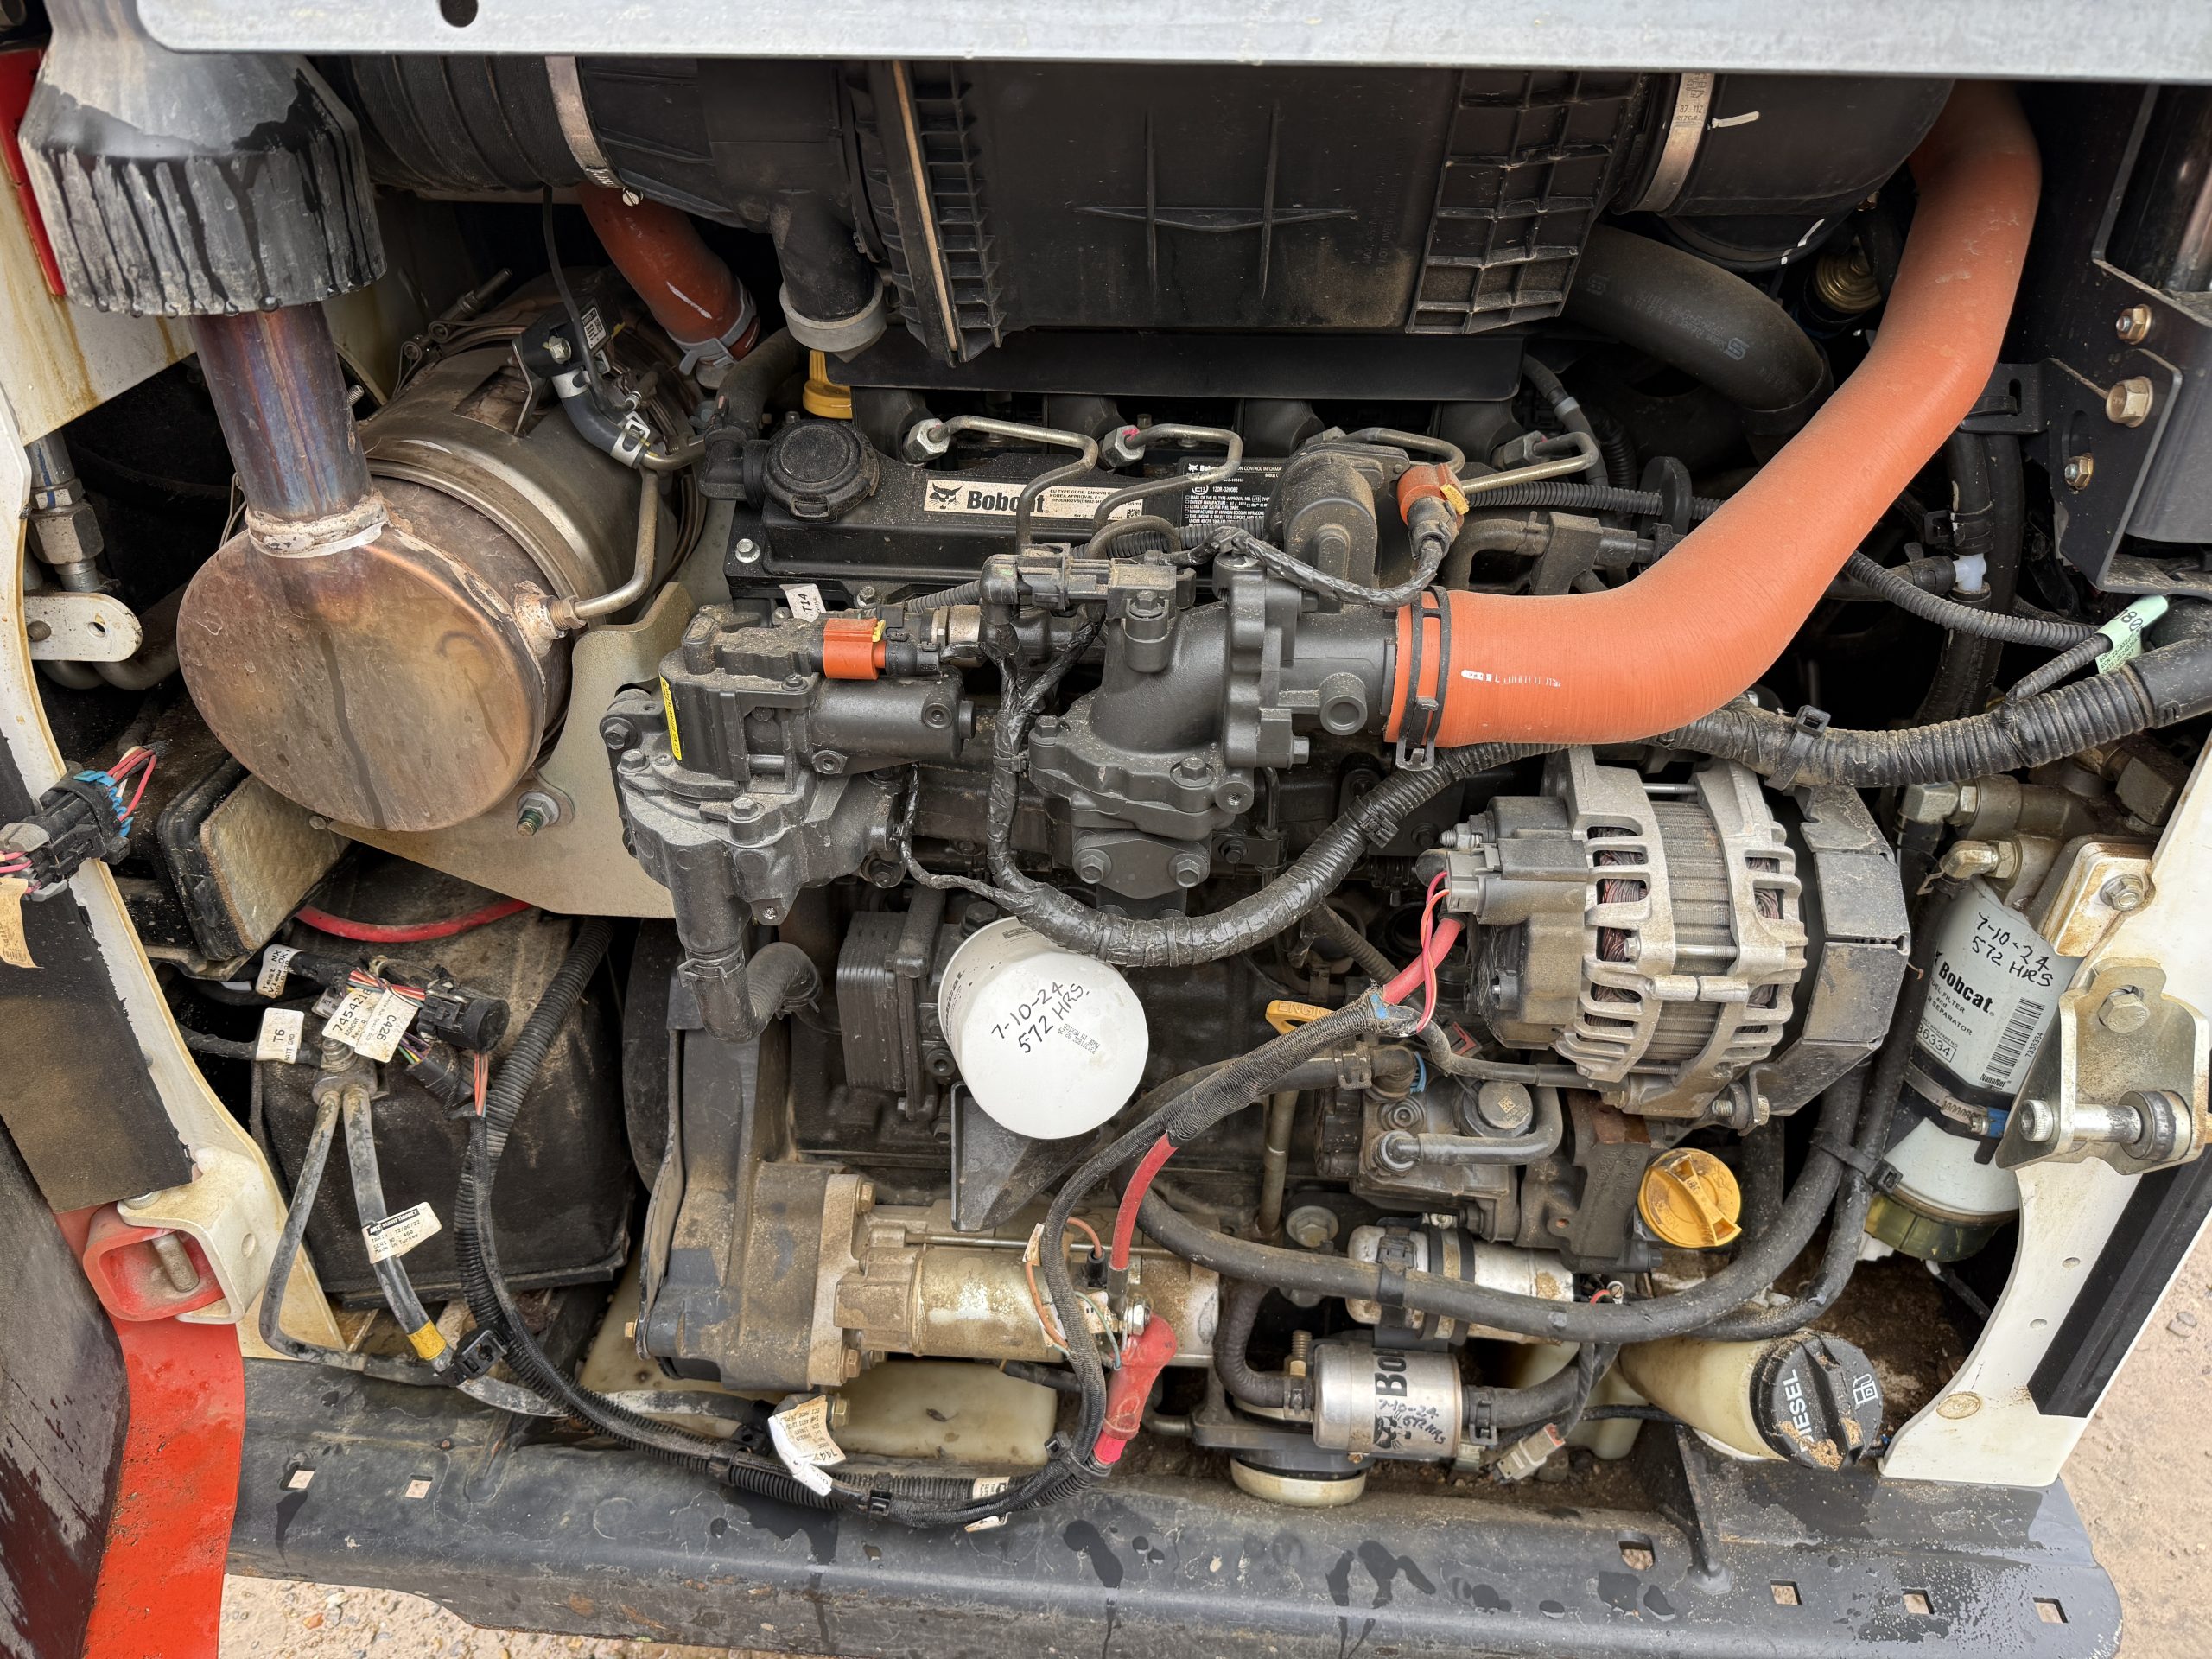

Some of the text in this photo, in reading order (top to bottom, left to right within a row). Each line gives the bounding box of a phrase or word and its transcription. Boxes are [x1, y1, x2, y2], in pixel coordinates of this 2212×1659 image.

[966, 490, 1045, 512] Bobct
[798, 593, 813, 612] T14
[1977, 912, 2050, 972] 7-10-24
[1972, 935, 2054, 987] 572 HRS
[1938, 961, 1993, 1014] Bobcat
[991, 982, 1064, 1039] 7-10-24
[1278, 1001, 1331, 1017] ENGIN
[1936, 996, 1948, 1008] and
[1942, 991, 1966, 1014] FILTER
[344, 1017, 361, 1038] BOBCAT
[376, 1014, 397, 1041] C426
[1063, 1023, 1080, 1037] MEXICO
[1931, 1001, 1974, 1036] SEPARATOR
[272, 1028, 286, 1043] T6
[1018, 1015, 1054, 1053] 572
[1087, 1036, 1101, 1049] MADE
[1917, 1023, 1951, 1058] 36334
[2024, 1032, 2044, 1058] 7336334
